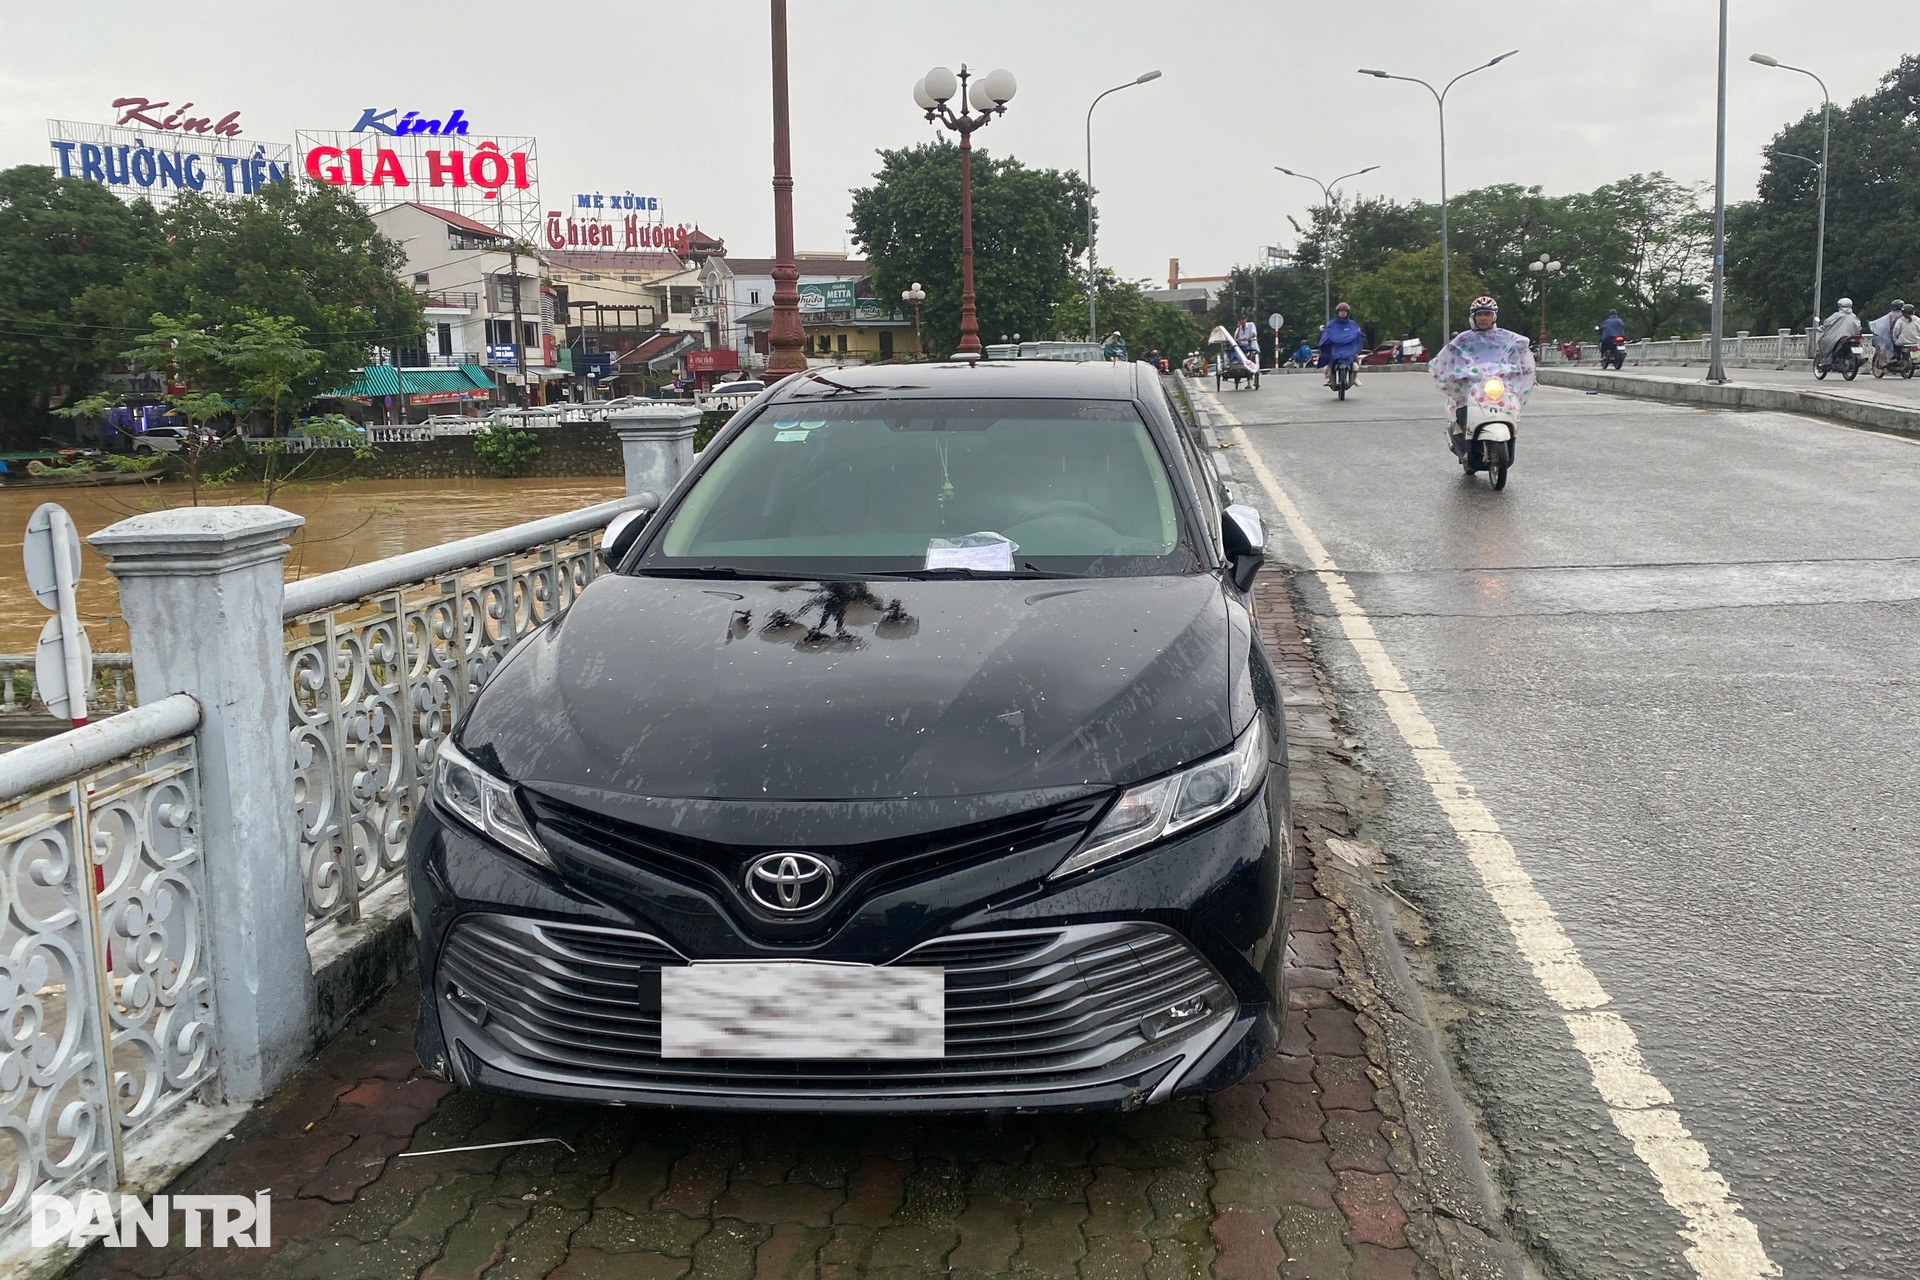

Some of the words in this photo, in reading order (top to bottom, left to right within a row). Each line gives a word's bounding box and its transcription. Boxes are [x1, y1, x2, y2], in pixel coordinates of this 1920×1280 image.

[112, 97, 243, 137] Kính
[351, 108, 470, 136] Kính
[50, 138, 206, 191] TRƯỜNG
[306, 146, 410, 186] GIA
[425, 141, 531, 199] HỘI
[577, 191, 604, 208] MÈ
[610, 190, 658, 211] XỬNG
[547, 211, 614, 249] Thiên
[624, 213, 689, 255] Hương
[826, 290, 851, 299] METTA
